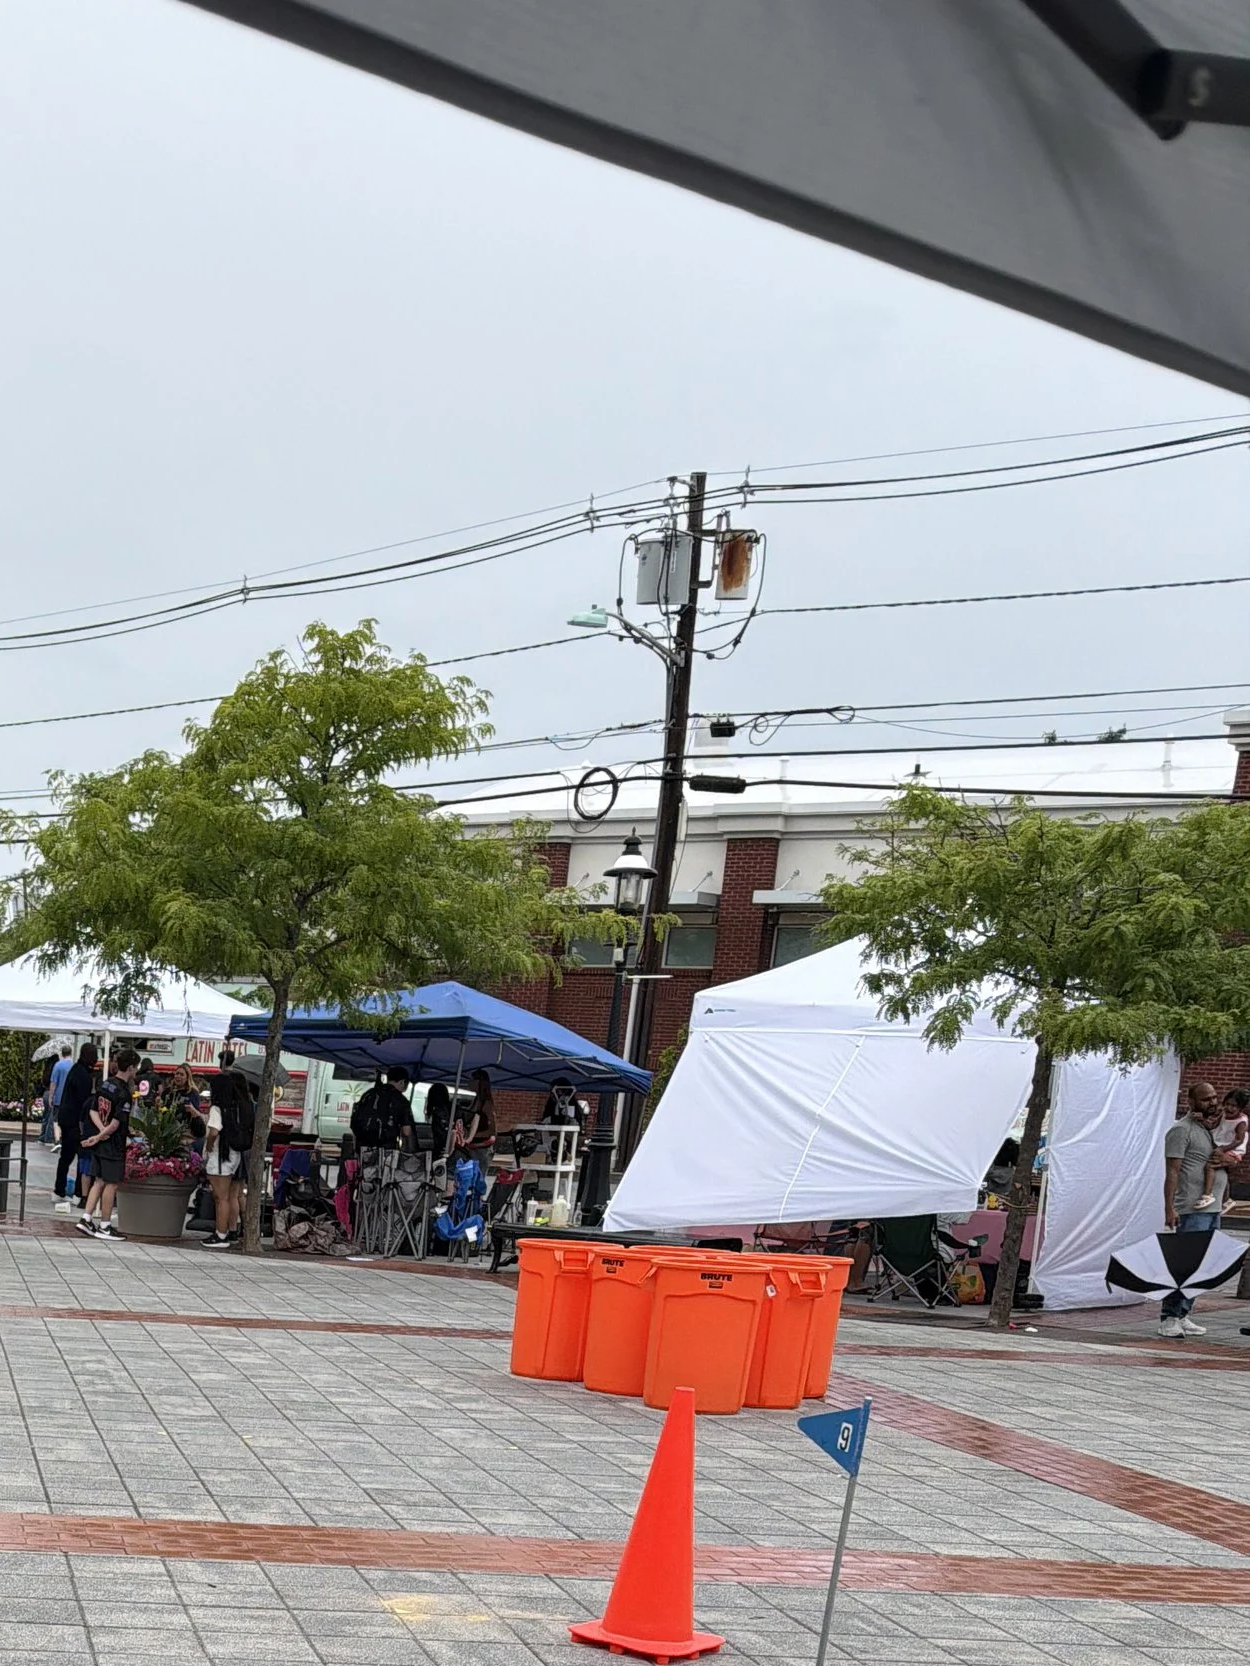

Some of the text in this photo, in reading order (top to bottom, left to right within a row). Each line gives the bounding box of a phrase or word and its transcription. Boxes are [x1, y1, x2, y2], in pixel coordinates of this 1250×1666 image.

[185, 1040, 216, 1064] LATIN
[601, 1258, 625, 1267] BRUTE
[700, 1272, 733, 1282] BRUTE
[839, 1426, 851, 1451] 9
